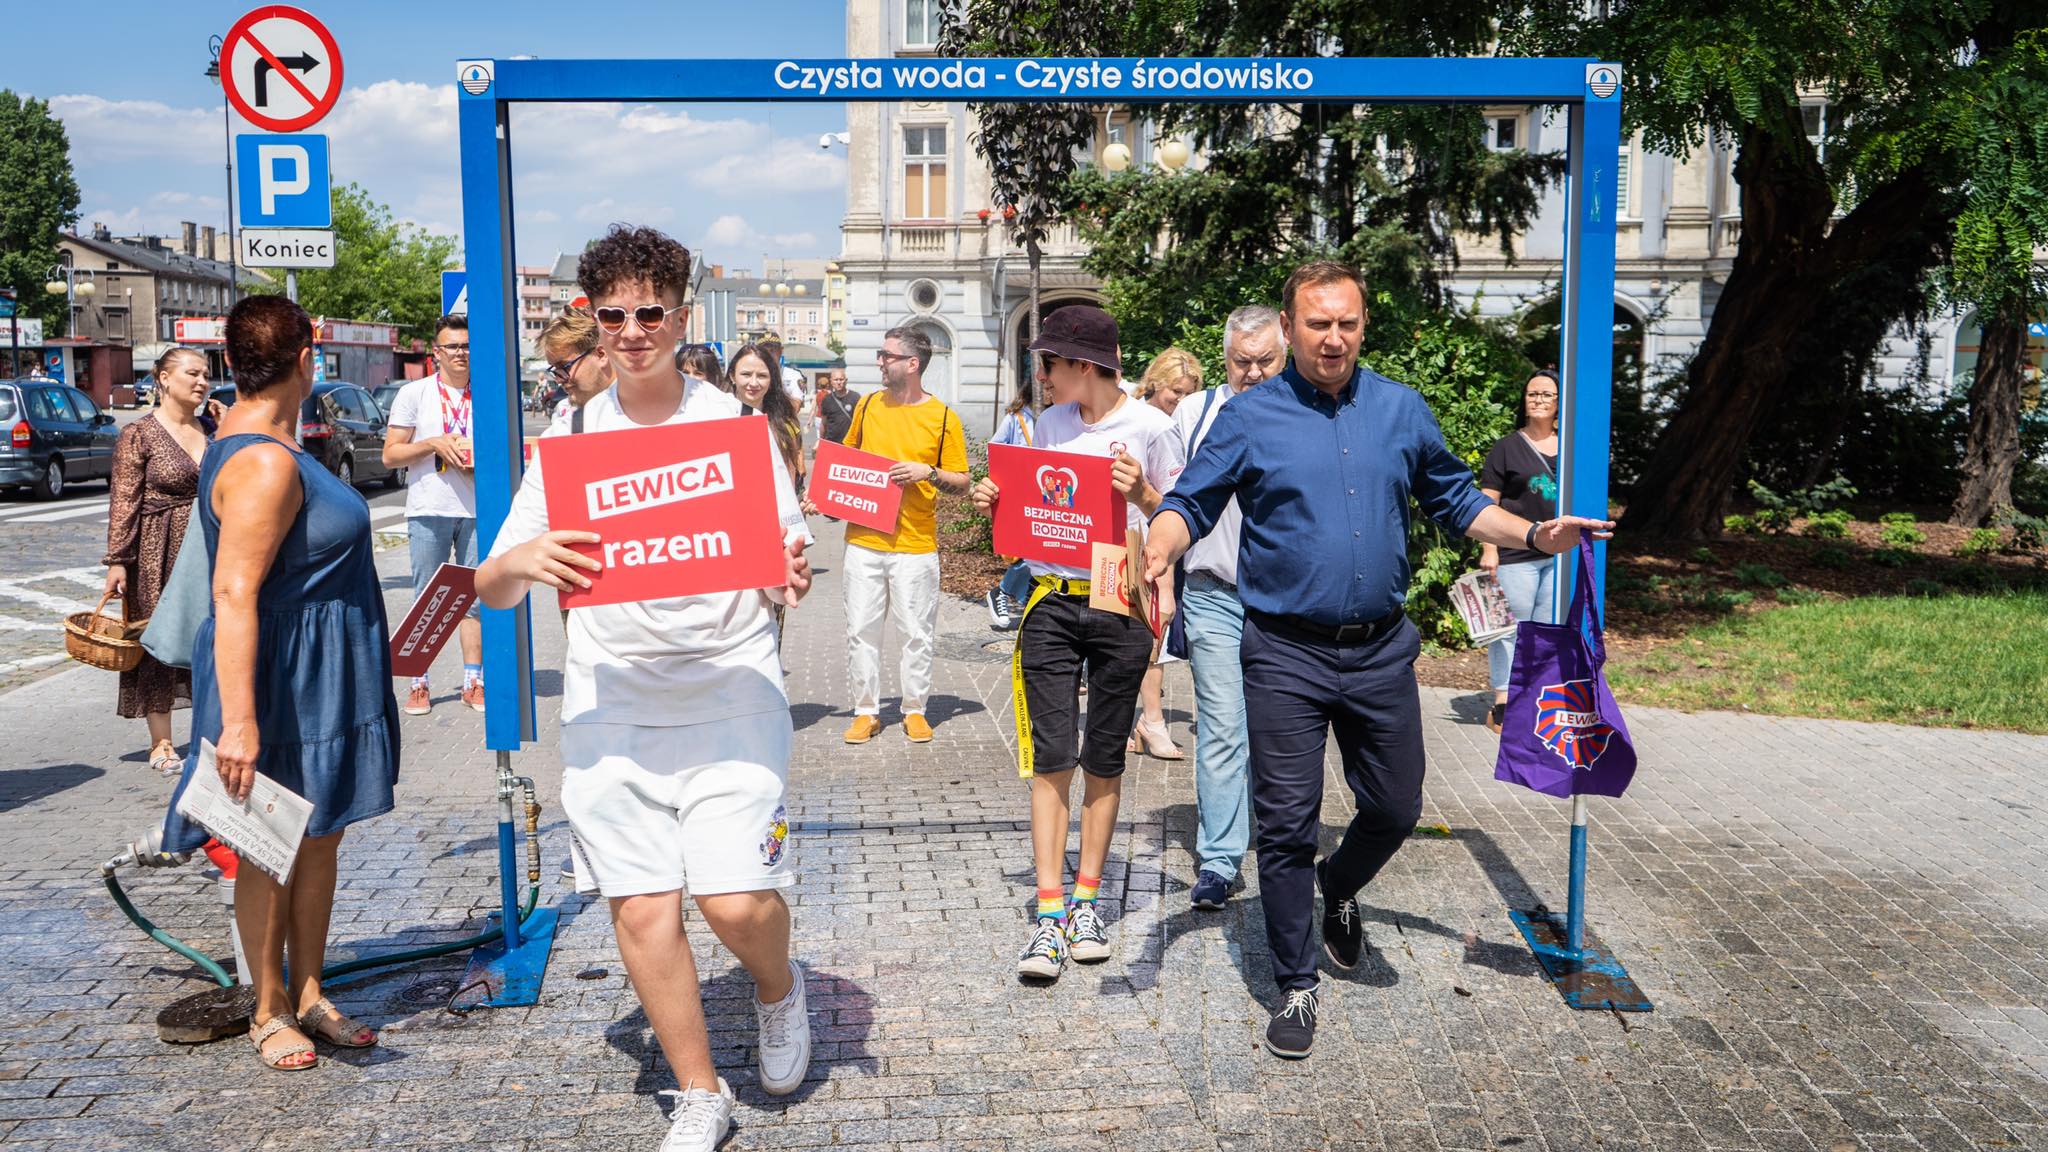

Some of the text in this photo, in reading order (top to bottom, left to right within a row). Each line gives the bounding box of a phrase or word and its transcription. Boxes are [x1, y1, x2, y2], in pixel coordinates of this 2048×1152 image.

[774, 60, 882, 95] Czysta
[892, 60, 986, 88] woda
[1015, 59, 1122, 94] Czyste
[1131, 58, 1314, 90] środowisko
[258, 144, 310, 215] P
[248, 239, 328, 257] Koniec
[595, 461, 725, 512] LEWICA
[832, 466, 885, 485] LEWICA
[827, 489, 878, 513] razem
[1024, 506, 1093, 526] BEZPIECZNA
[603, 529, 732, 569] razem
[1033, 523, 1085, 541] RODZINA
[402, 589, 447, 653] LEWICA
[420, 592, 468, 653] razem
[207, 813, 285, 869] POLSKA RODZINA
